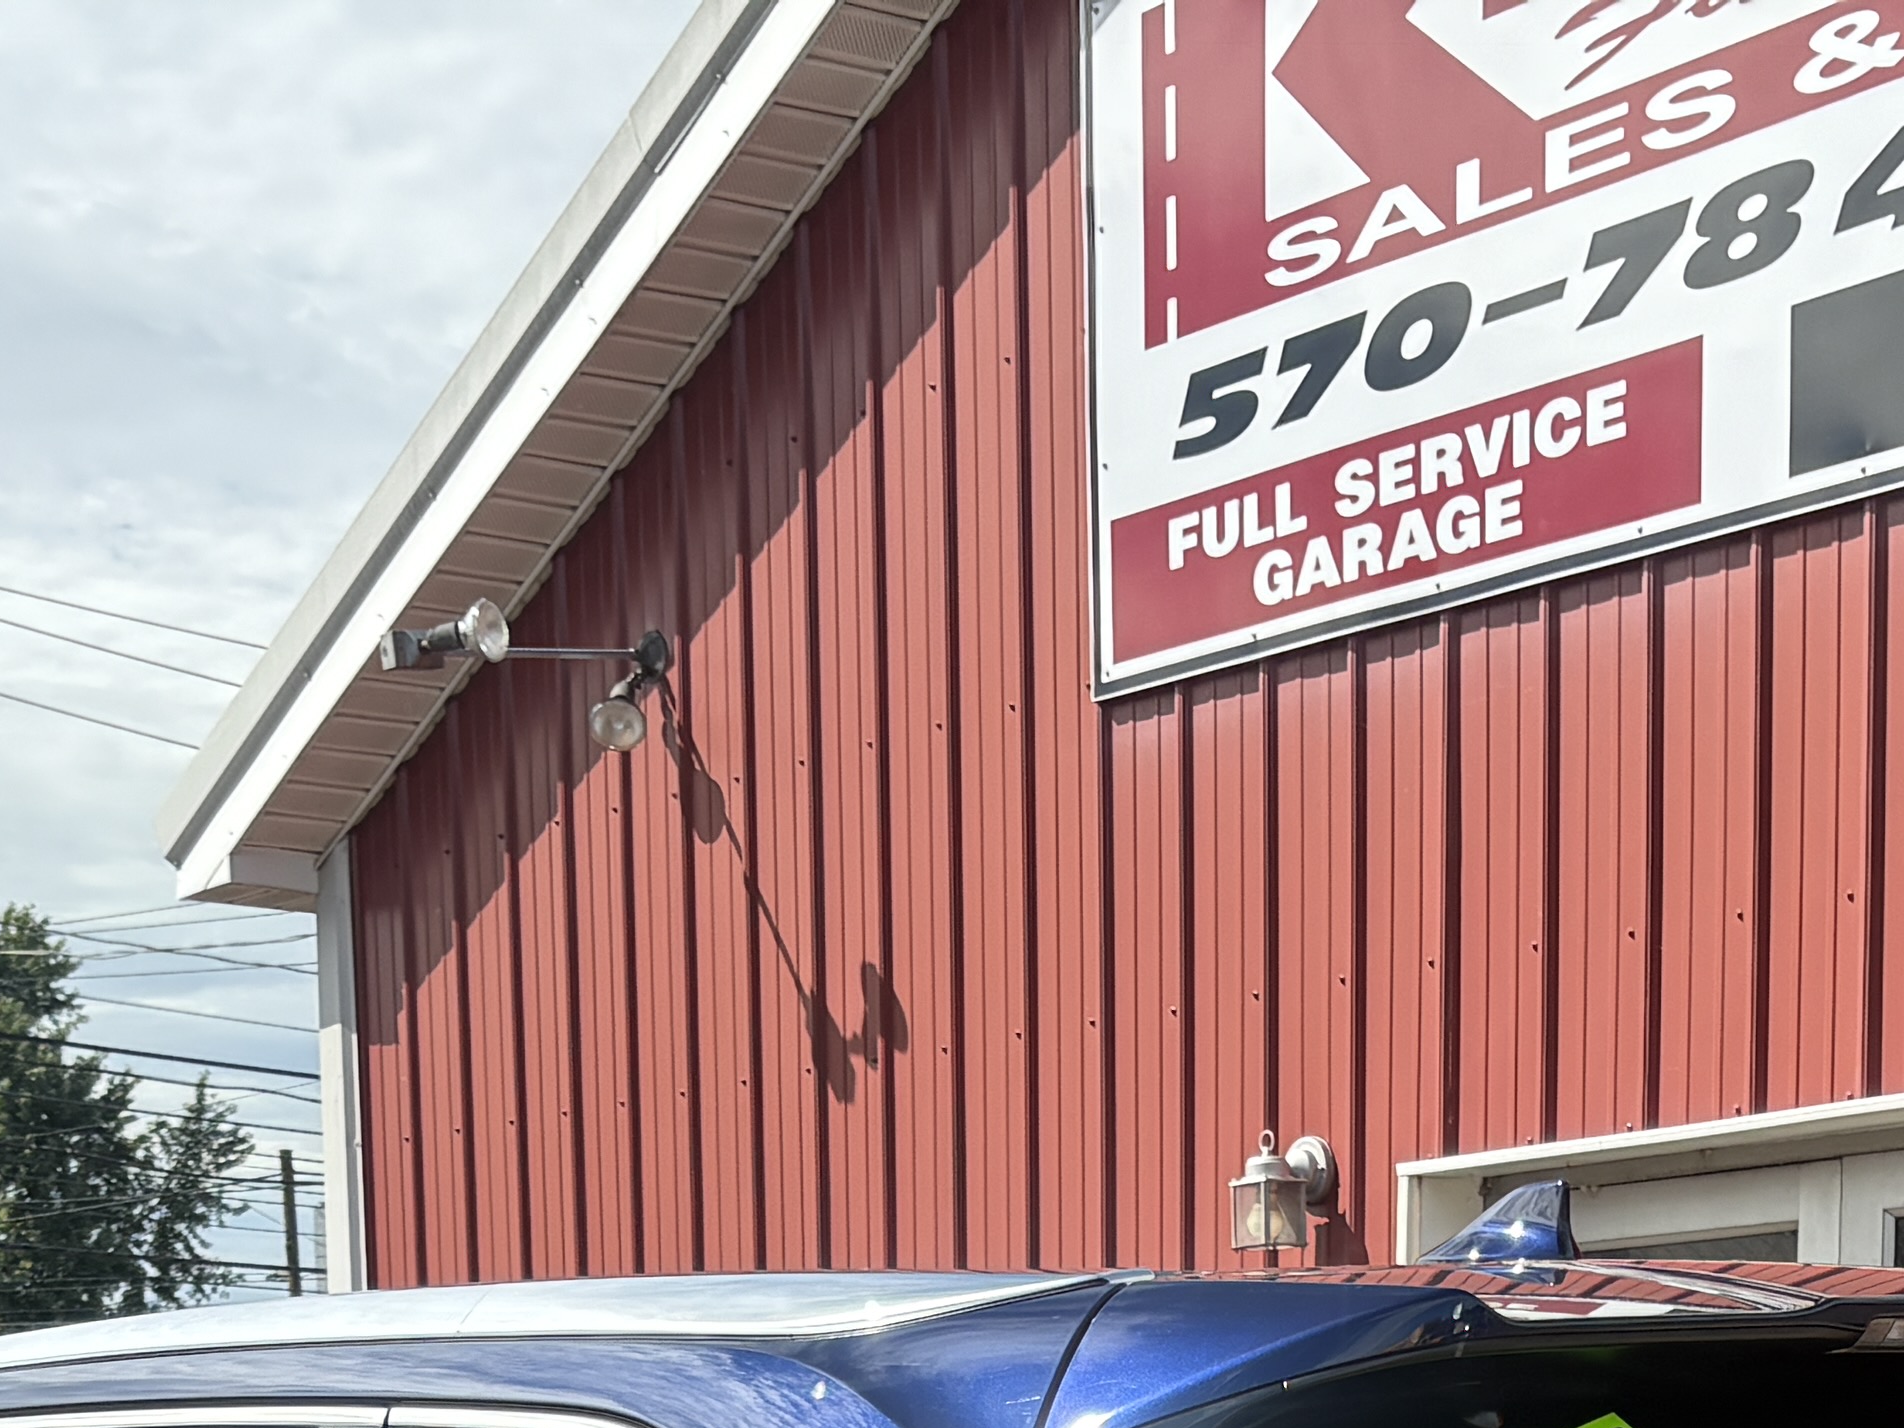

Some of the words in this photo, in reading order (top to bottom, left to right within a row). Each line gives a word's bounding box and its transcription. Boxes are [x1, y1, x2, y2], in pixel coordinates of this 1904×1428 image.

[1264, 68, 1737, 287] SALES
[1167, 481, 1308, 571] FULL
[1334, 378, 1628, 518] SERVICE
[1252, 479, 1524, 606] GARAGE
